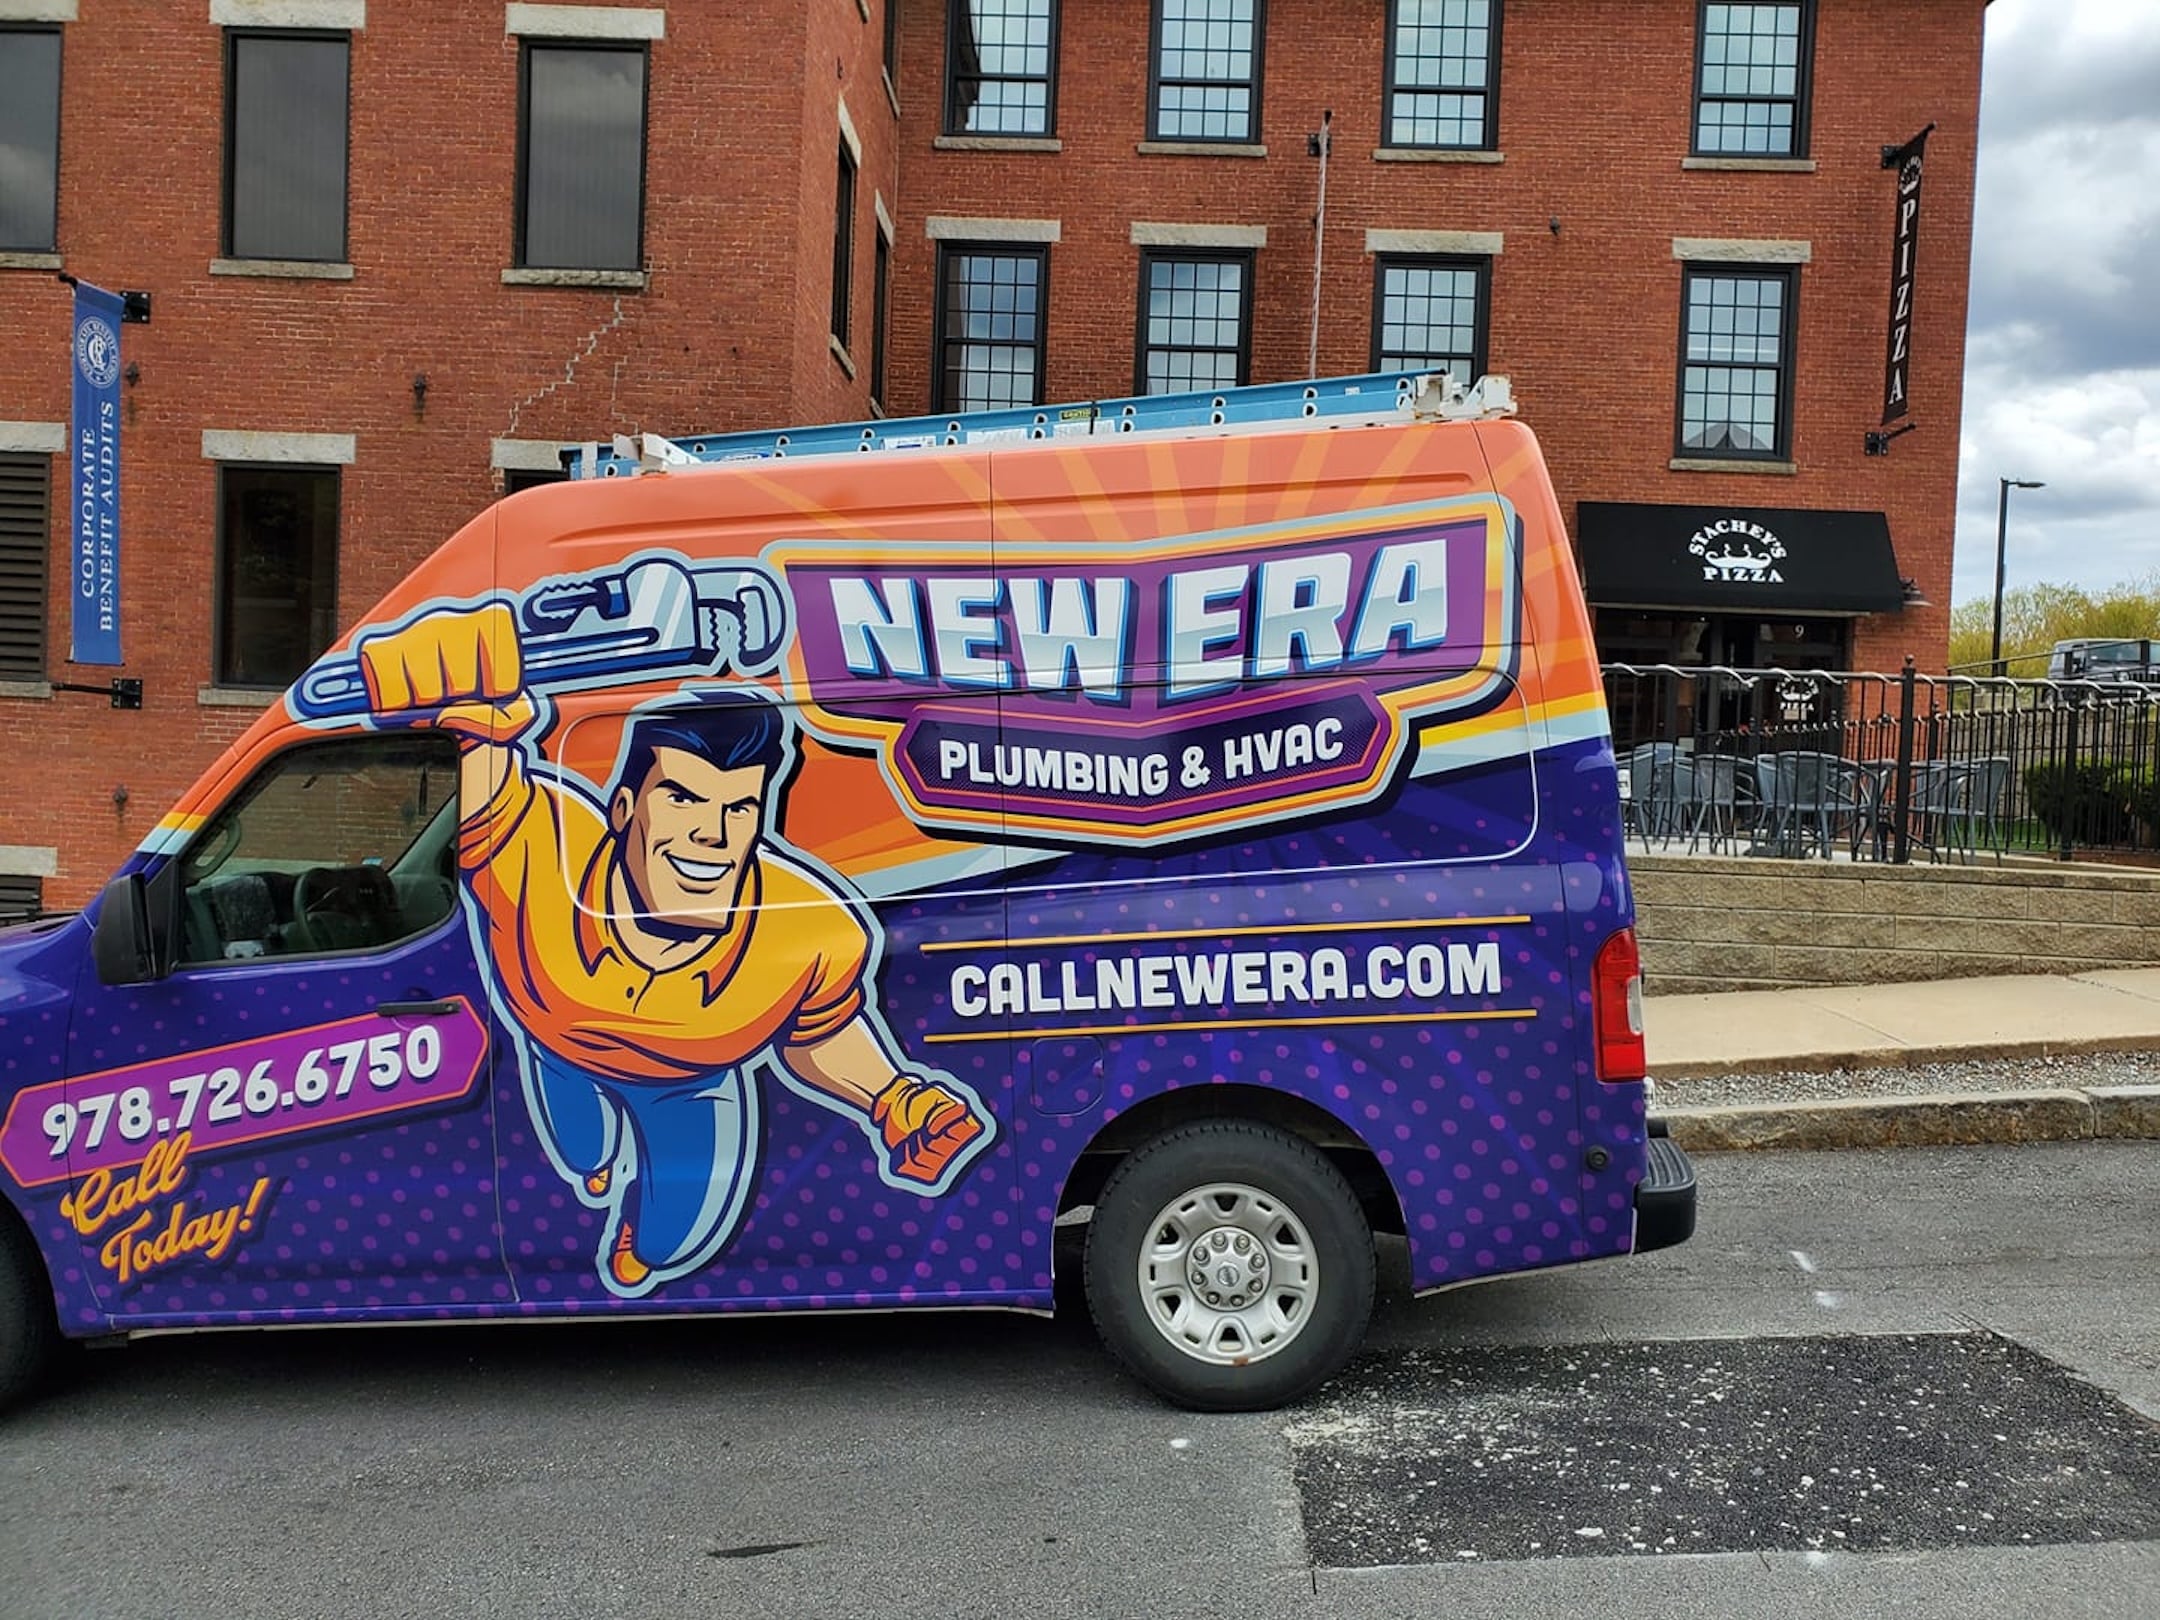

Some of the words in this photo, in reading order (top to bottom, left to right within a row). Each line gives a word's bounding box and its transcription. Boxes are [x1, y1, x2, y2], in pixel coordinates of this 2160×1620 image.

[1889, 199, 1916, 404] PIZZA
[101, 402, 113, 504] AUDITS
[82, 428, 95, 598] CORPORATE
[1689, 519, 1787, 558] STACHEY'S
[101, 512, 113, 632] BENEFIT
[829, 576, 1132, 706] NEW
[1160, 538, 1449, 706] ERA
[1703, 566, 1784, 583] PIZZA
[1795, 624, 1804, 638] 9
[940, 738, 1169, 798] PLUMBING
[1180, 745, 1211, 787] &
[1223, 716, 1344, 778] HVAC
[950, 942, 1502, 1018] CALLNEWERA.COM
[41, 1023, 442, 1157] 978.726.6750
[60, 1131, 194, 1236] Call
[100, 1176, 271, 1284] Today!
